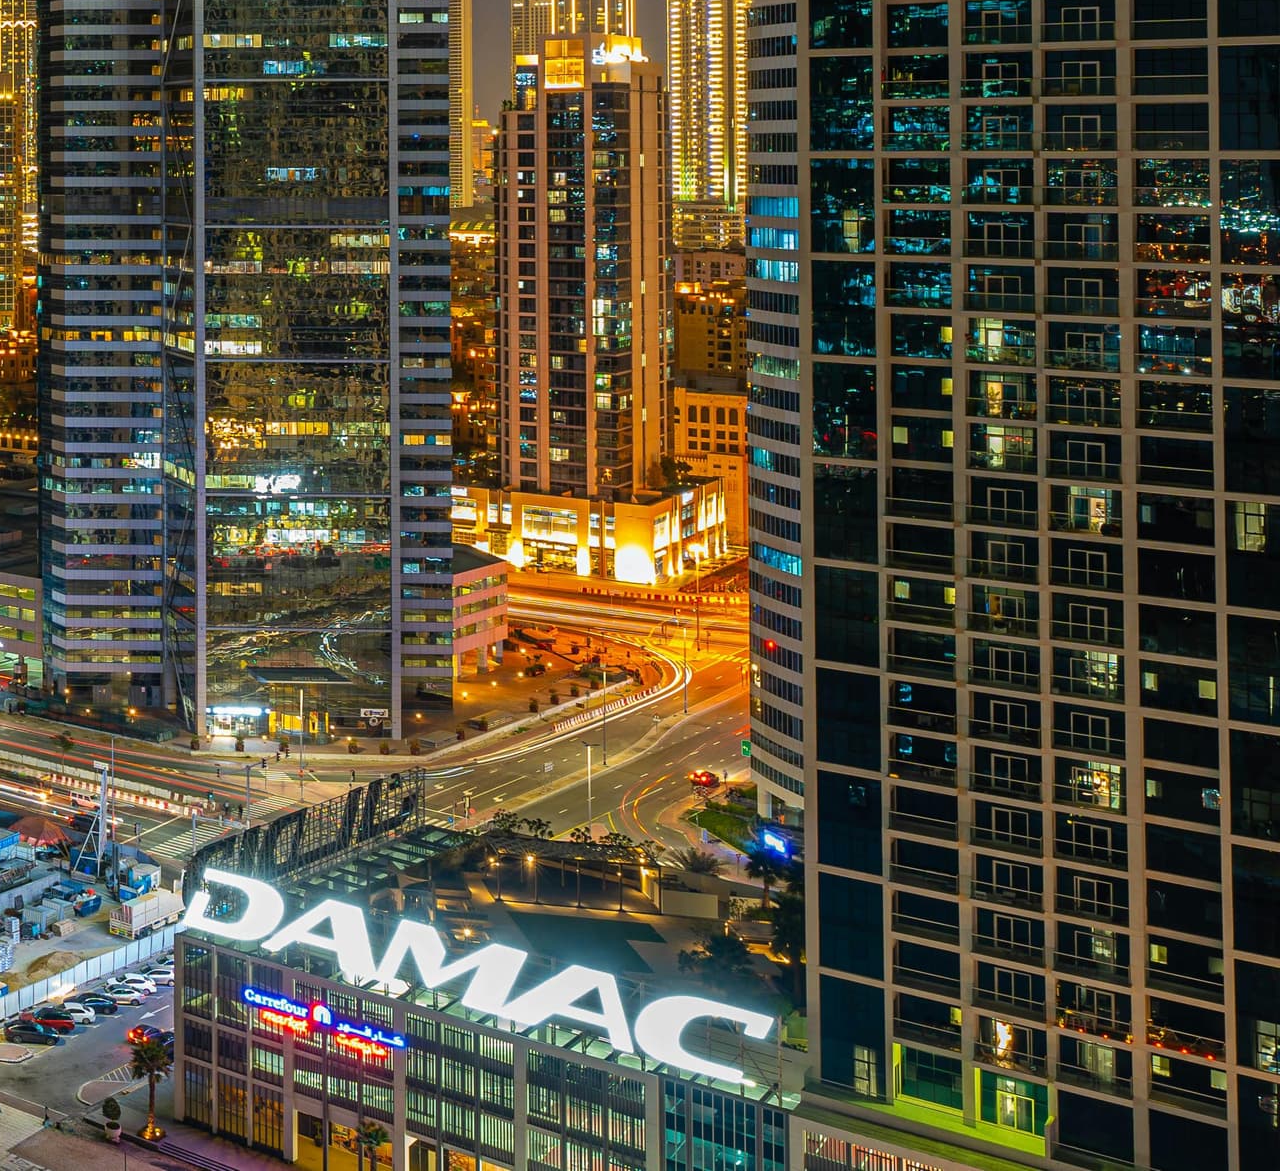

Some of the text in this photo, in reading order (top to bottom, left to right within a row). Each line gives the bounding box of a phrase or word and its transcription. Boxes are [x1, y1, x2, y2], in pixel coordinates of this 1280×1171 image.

[183, 868, 774, 1086] DAMAC
[244, 989, 308, 1018] Carrefour
[262, 1010, 308, 1032] market
